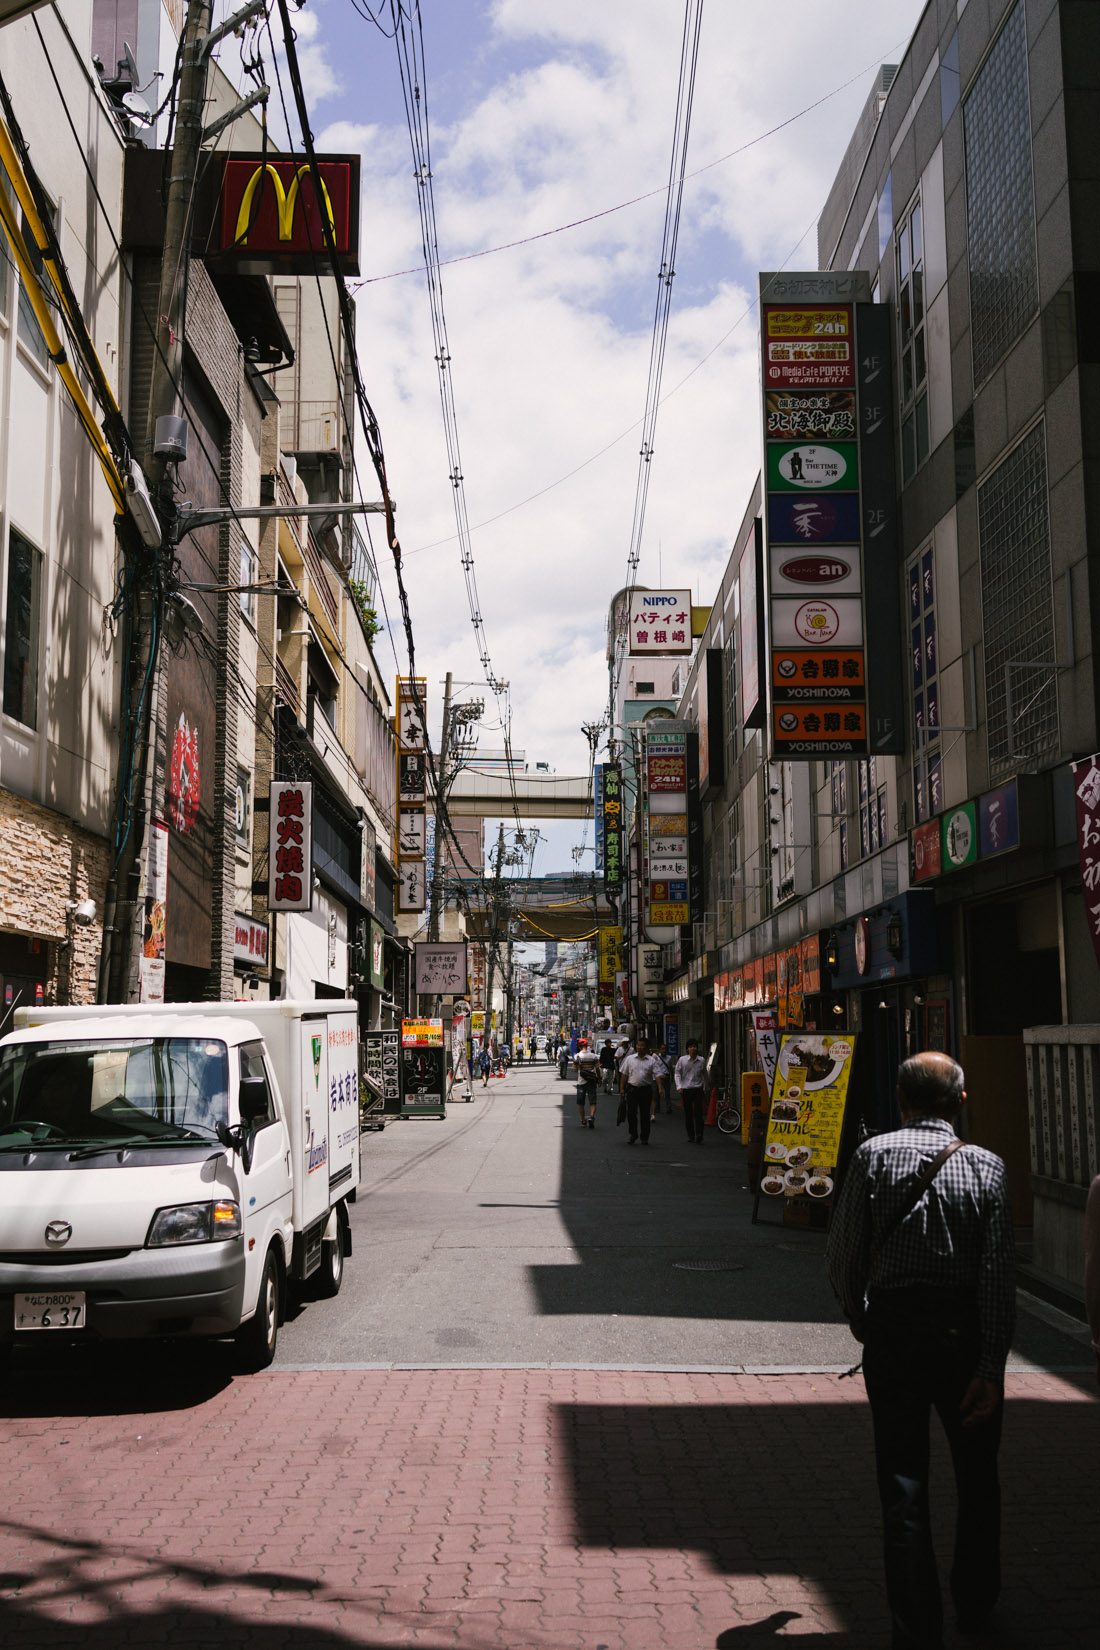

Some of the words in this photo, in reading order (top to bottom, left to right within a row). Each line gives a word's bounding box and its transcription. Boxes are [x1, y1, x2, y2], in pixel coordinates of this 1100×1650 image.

[774, 279, 865, 296] お初天神ビル
[770, 312, 846, 323] インターネット
[770, 325, 812, 335] コミック
[814, 322, 847, 334] 24h
[862, 356, 880, 370] 4F
[782, 366, 802, 377] Media
[802, 366, 818, 377] Cafe
[819, 366, 851, 377] POPEYE
[768, 411, 855, 431] 北海御殿
[864, 407, 881, 421] 3F
[867, 509, 885, 524] 2F
[819, 564, 843, 576] an
[642, 596, 678, 606] NIPPO
[633, 611, 689, 625] パティオ
[801, 659, 860, 679] 吉野家
[787, 687, 852, 698] YOSHINOYA
[802, 712, 862, 733] 吉野家
[876, 718, 893, 733] 1F
[788, 741, 853, 752] YOSHINOYA
[275, 789, 304, 902] 炭火焼肉
[606, 833, 619, 882] 寿司本店
[652, 864, 675, 872] 居酒屋
[428, 963, 456, 971] 食べ放題
[382, 1034, 399, 1098] 和民の宴会は
[330, 1068, 358, 1113] 岩本商店
